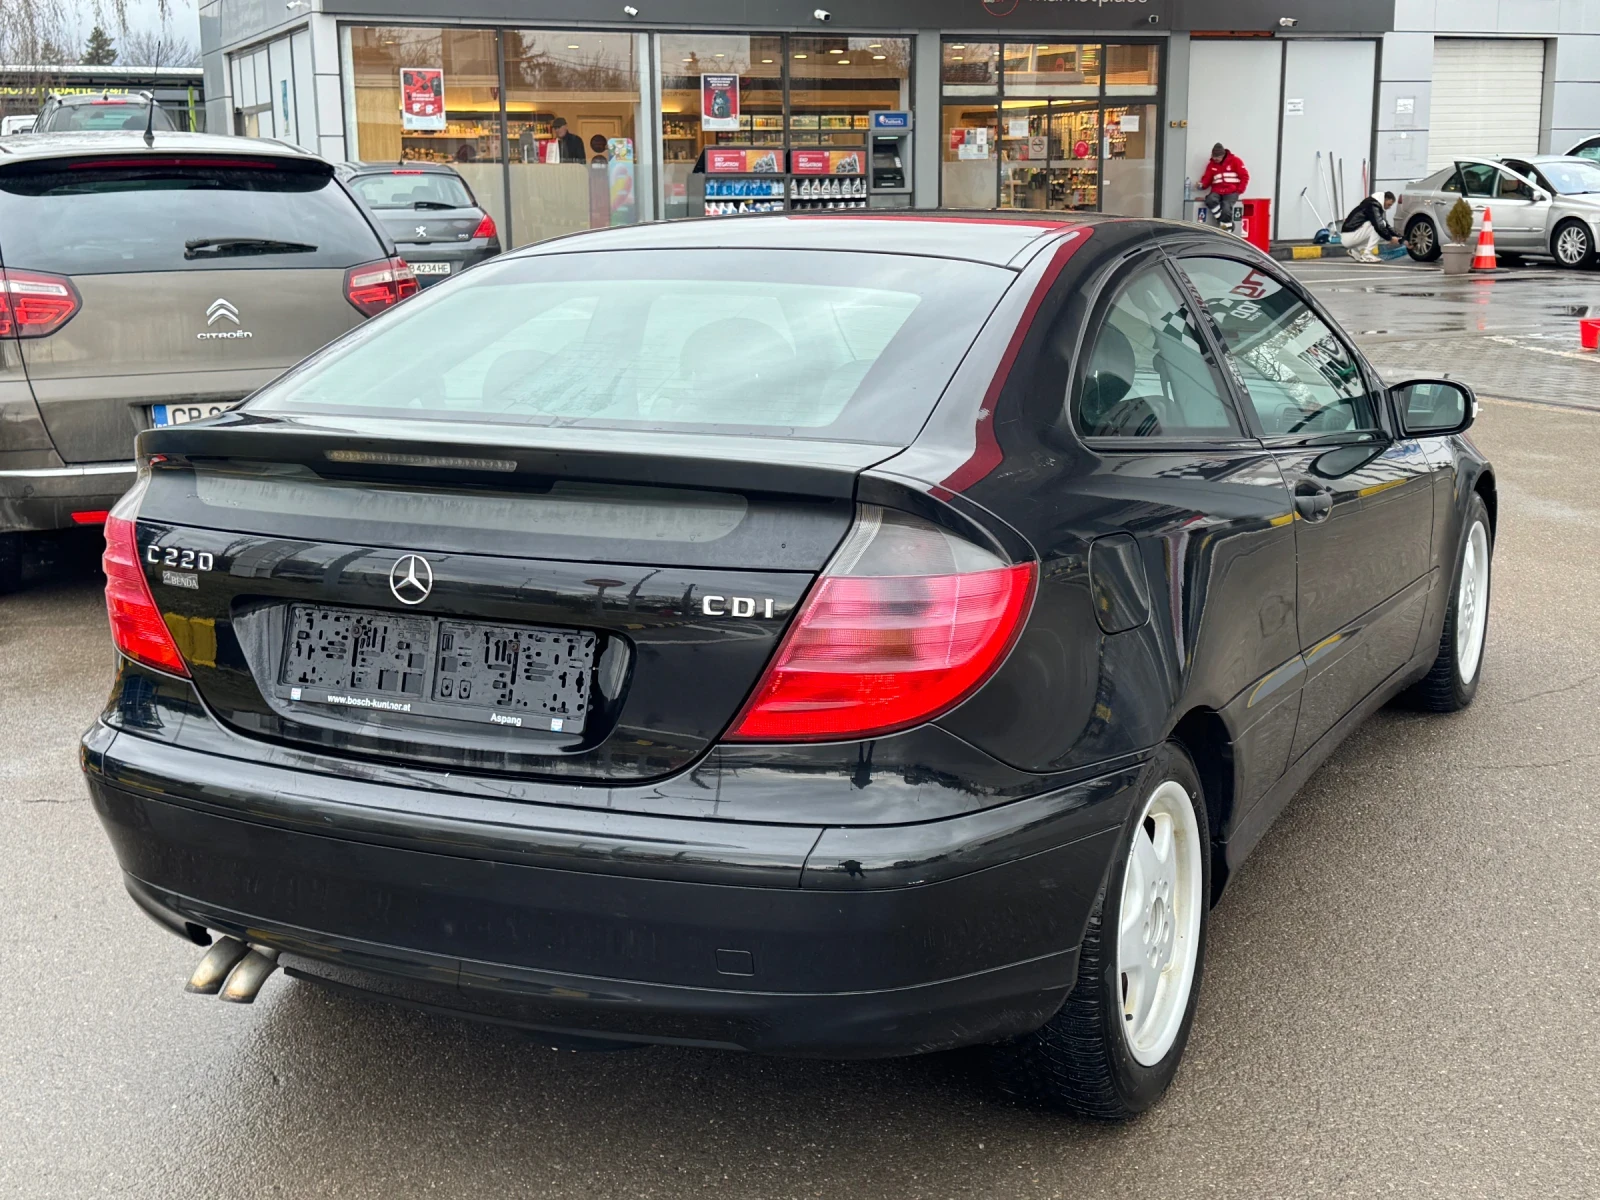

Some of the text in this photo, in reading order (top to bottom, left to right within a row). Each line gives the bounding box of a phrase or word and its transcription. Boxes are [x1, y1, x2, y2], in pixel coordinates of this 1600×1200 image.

[171, 575, 199, 589] BENDA
[703, 595, 774, 619] CDI
[490, 712, 522, 727] Aspang
